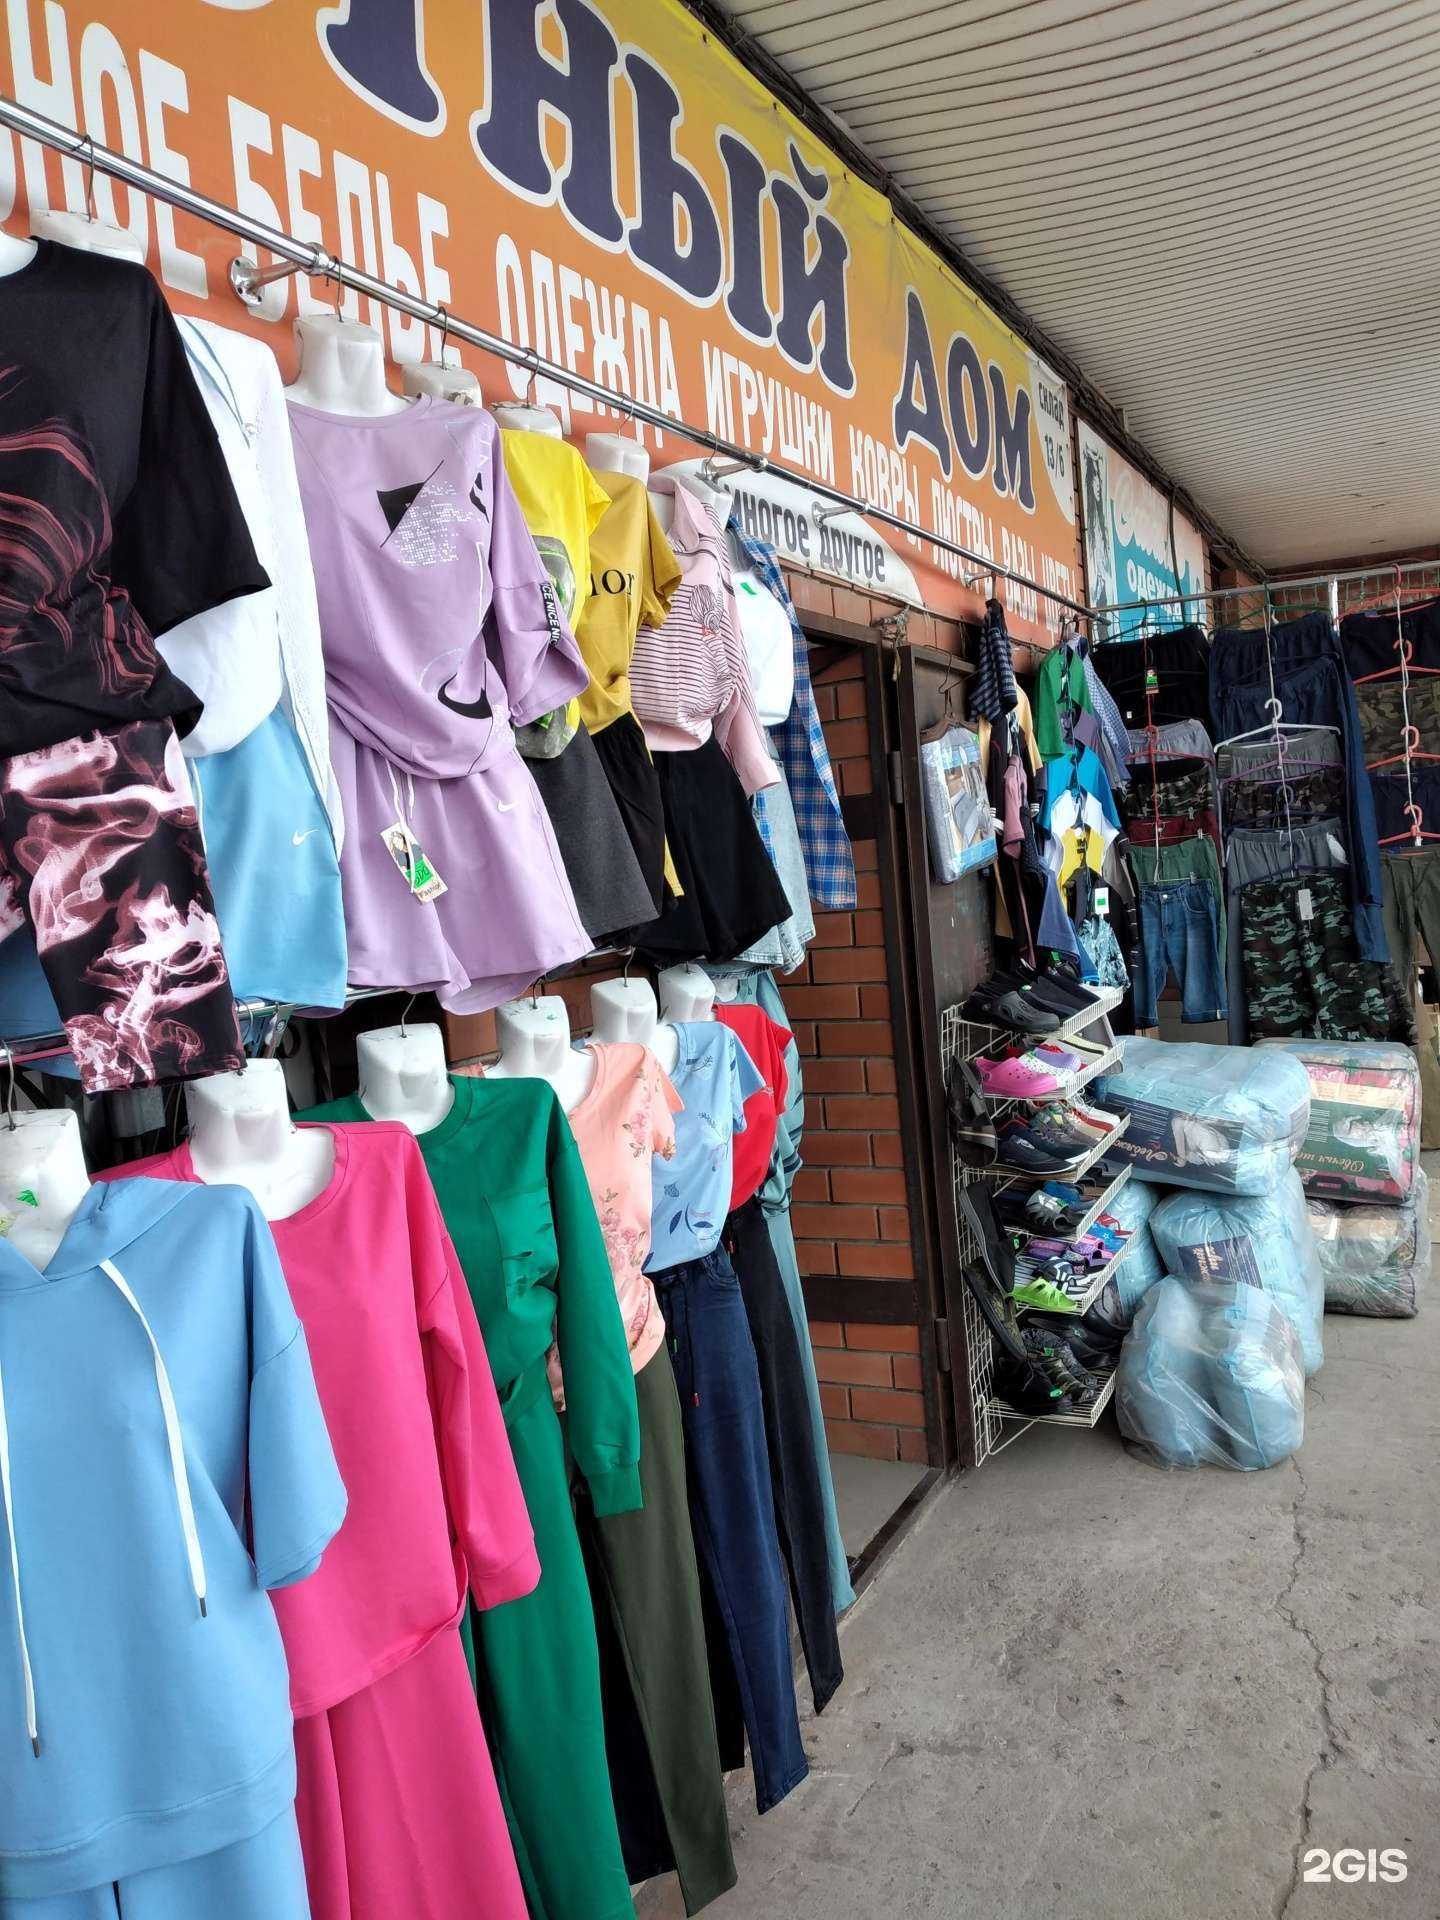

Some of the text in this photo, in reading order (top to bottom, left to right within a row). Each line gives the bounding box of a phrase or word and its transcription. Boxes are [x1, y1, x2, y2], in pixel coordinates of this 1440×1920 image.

[0, 0, 208, 299] НОЕ
[228, 95, 463, 368] БЕЛЬЕ
[496, 233, 684, 449] ОДЕЖДА
[702, 340, 836, 487] ИГРУШКИ
[849, 424, 922, 553] КОВРЫ
[931, 478, 994, 600] ЛЮСТРЫ
[1002, 527, 1039, 625] ВАЗЫ
[893, 284, 1036, 516] ДОМ
[1038, 381, 1065, 433] склад
[1045, 432, 1065, 478] 13/6
[818, 524, 886, 582] другое
[546, 601, 561, 627] NICE
